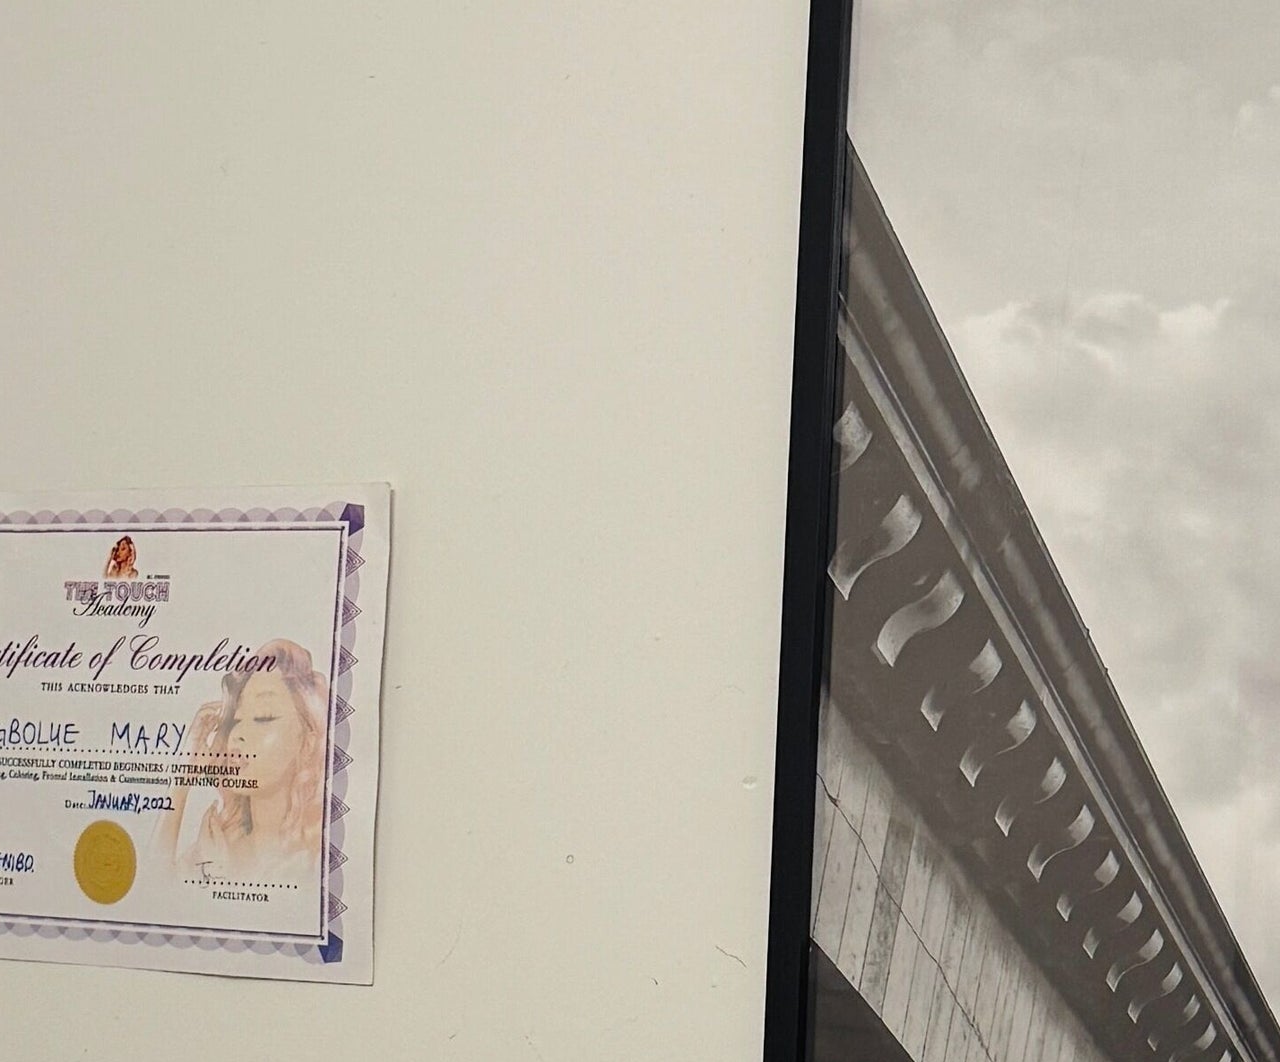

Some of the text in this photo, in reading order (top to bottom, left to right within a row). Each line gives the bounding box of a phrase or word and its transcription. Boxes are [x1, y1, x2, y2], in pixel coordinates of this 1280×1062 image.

[64, 581, 171, 602] THE TOUCH
[73, 591, 157, 629] Academy
[88, 635, 126, 681] of
[129, 634, 277, 683] Completion
[41, 682, 181, 695] THIS ACKNOWLEDGES THAT
[110, 722, 186, 755] MARY
[58, 759, 112, 771] COMPLETED
[114, 762, 164, 773] BEGINNERS
[171, 764, 241, 776] INTERMEDIARY
[110, 774, 117, 783] &
[174, 776, 219, 788] TRAINING
[212, 891, 269, 902] FACILITATOR
